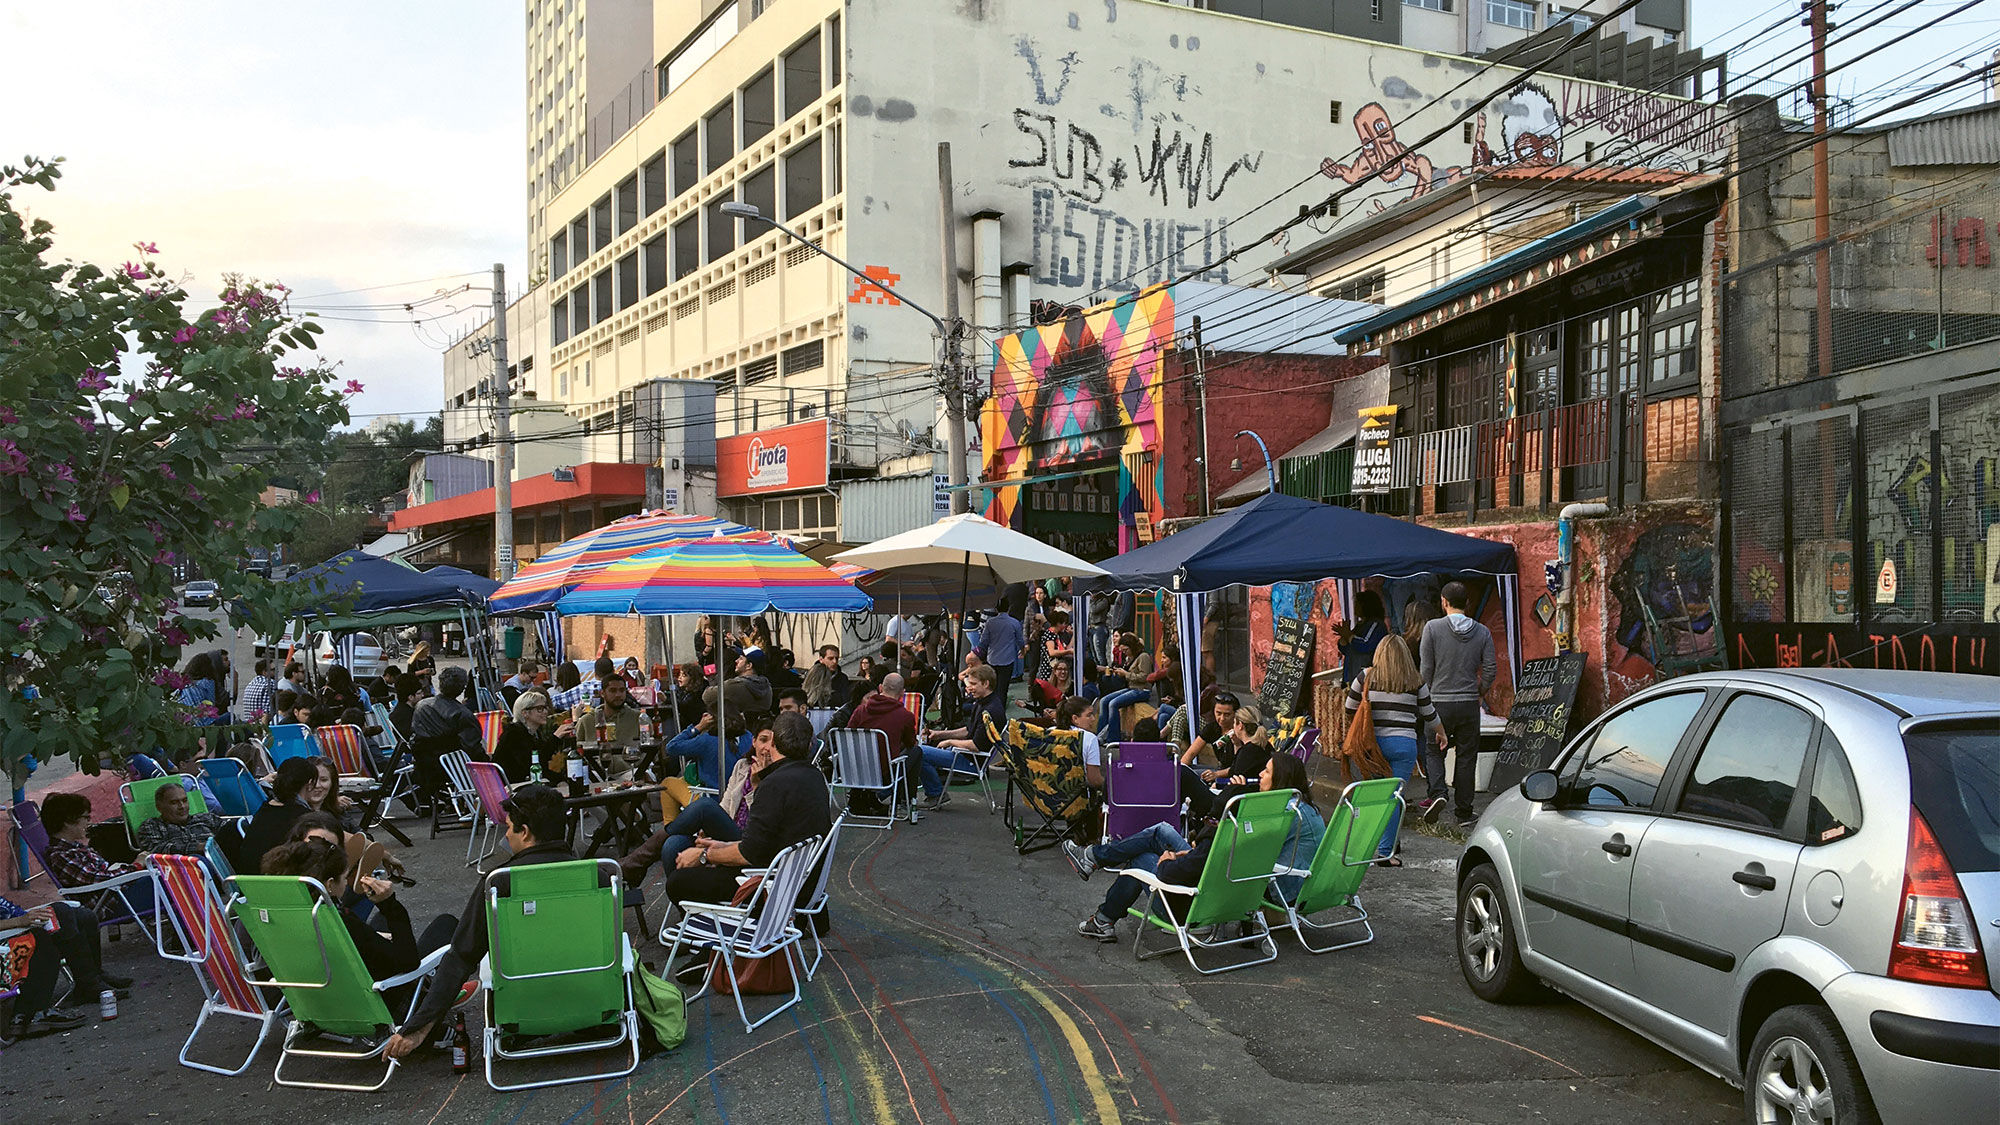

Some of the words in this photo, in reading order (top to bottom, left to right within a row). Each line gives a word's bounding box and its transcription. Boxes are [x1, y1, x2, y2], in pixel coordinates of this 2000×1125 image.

[1360, 428, 1389, 441] Pacheco
[749, 443, 788, 473] Hirota
[1355, 448, 1391, 466] ALUGA
[1352, 467, 1391, 485] 3815-2233
[1524, 659, 1559, 672] STELLA
